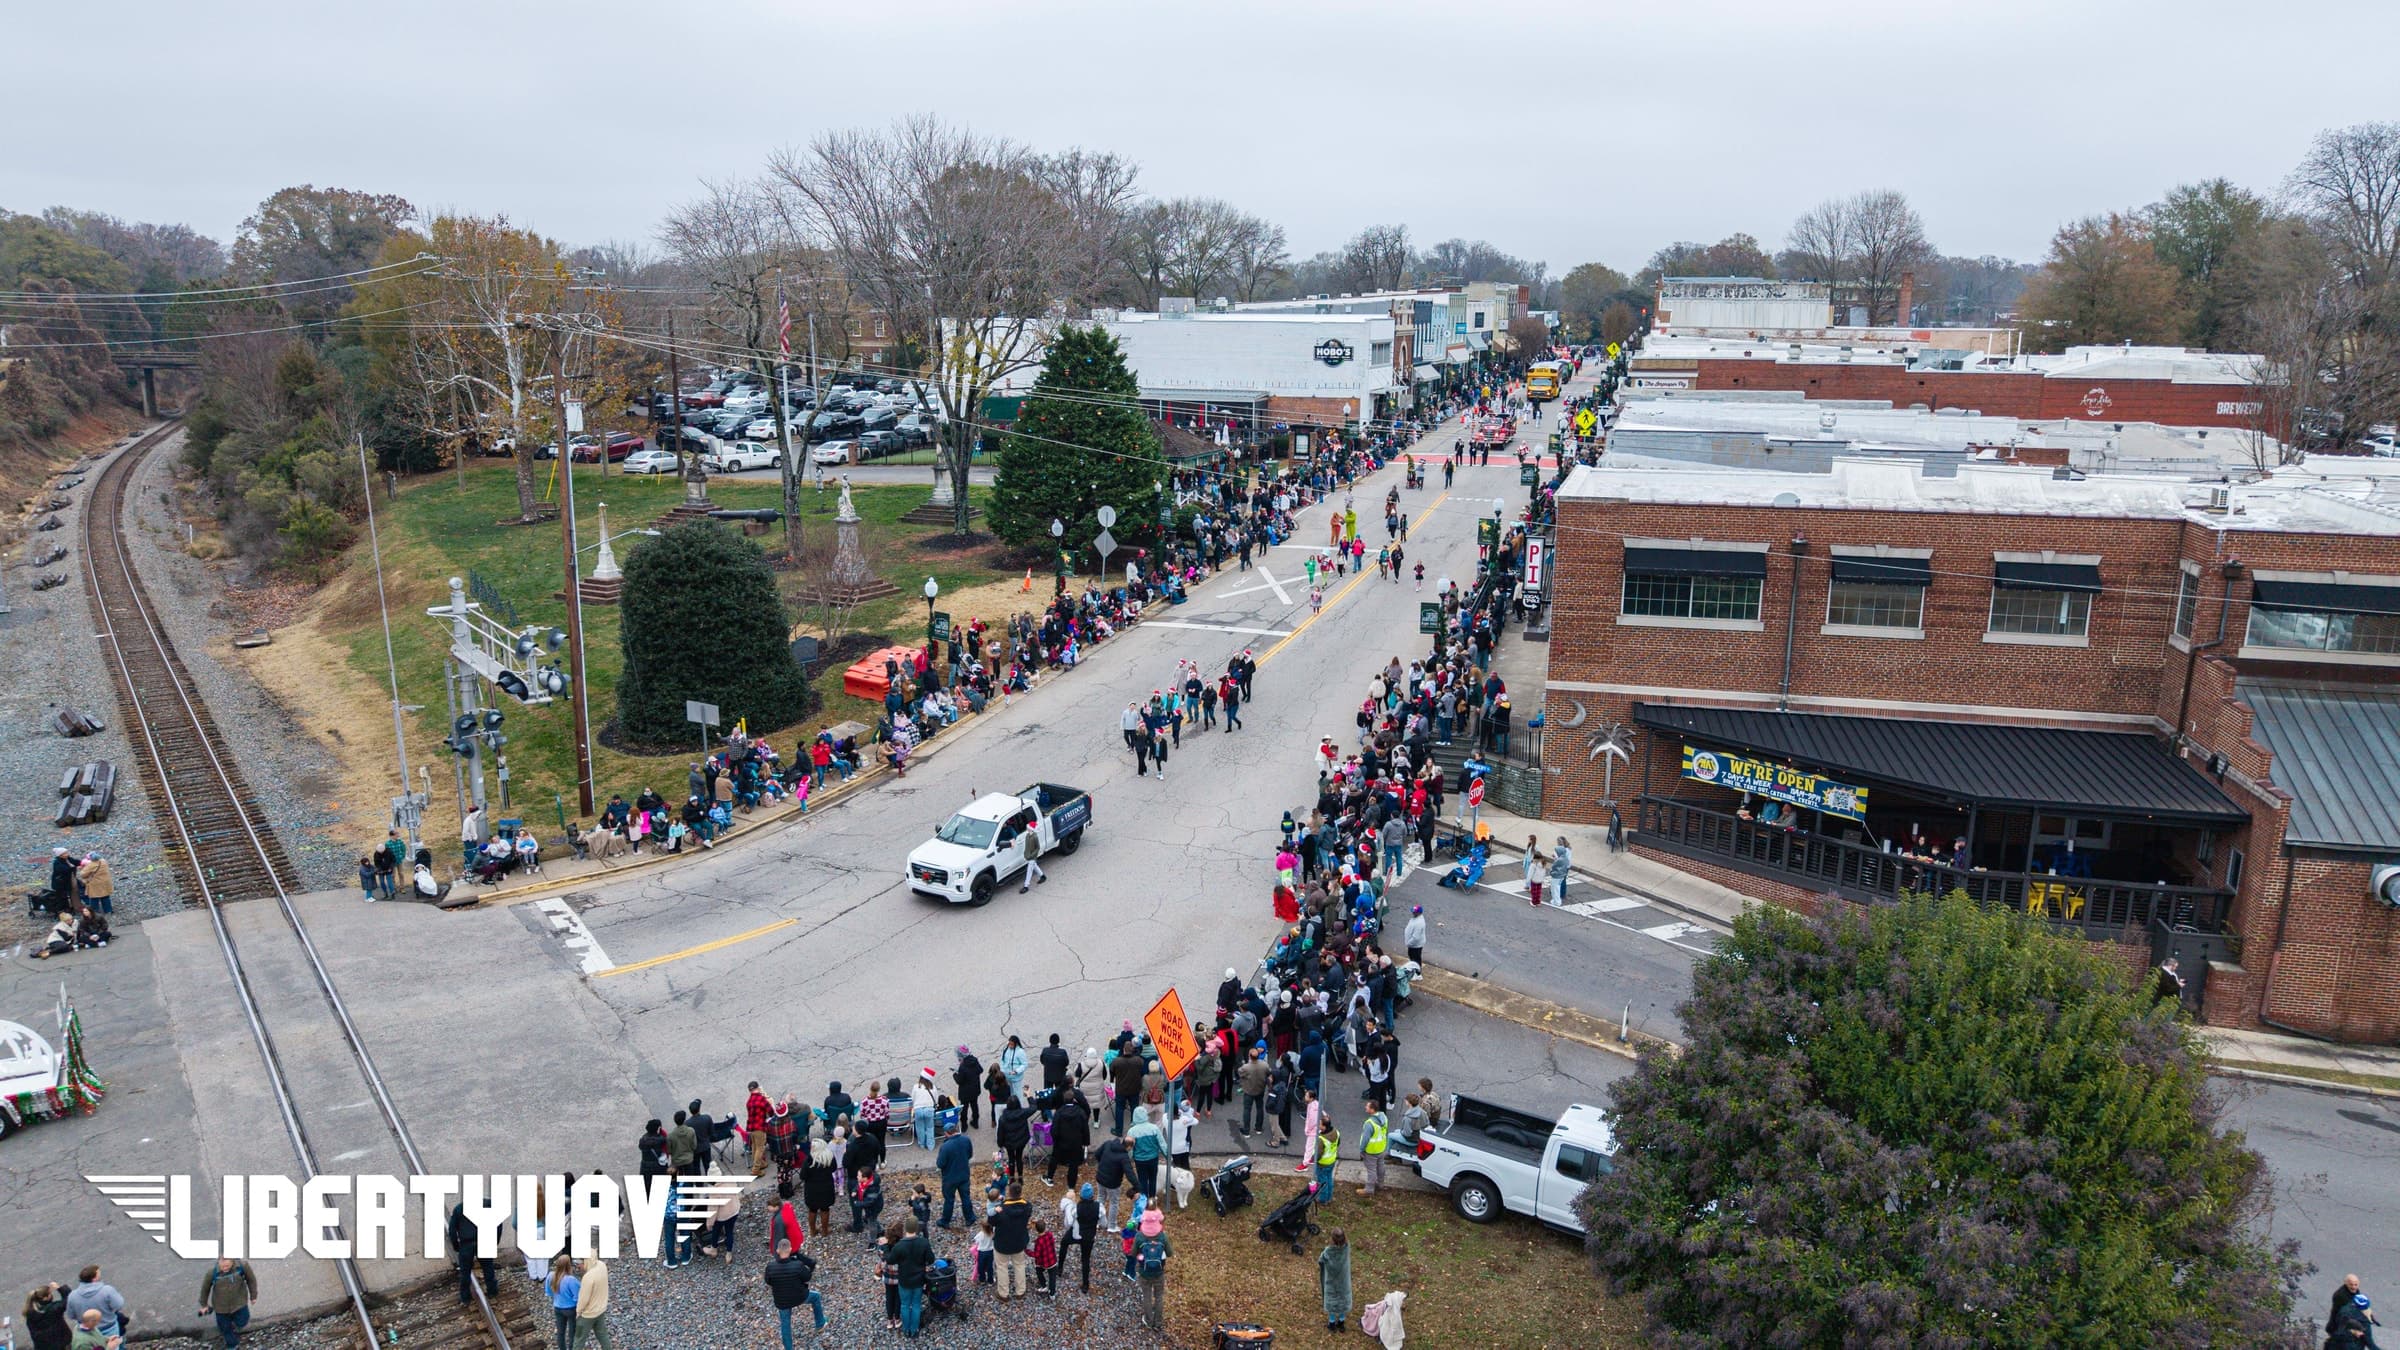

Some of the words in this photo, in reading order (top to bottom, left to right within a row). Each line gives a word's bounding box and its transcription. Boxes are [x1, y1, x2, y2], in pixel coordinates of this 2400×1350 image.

[1316, 348, 1351, 356] HOBO'S
[2216, 401, 2264, 415] BREWERY
[1728, 773, 1745, 782] DAYS
[1752, 778, 1771, 788] WEEK
[1730, 759, 1774, 782] WE'RE
[1777, 771, 1815, 793] OPEN
[1470, 785, 1484, 800] STOP
[1743, 783, 1757, 791] TAKE
[1162, 1008, 1183, 1029] ROAD
[1161, 1021, 1183, 1045] WORK
[1158, 1035, 1185, 1059] AHEAD
